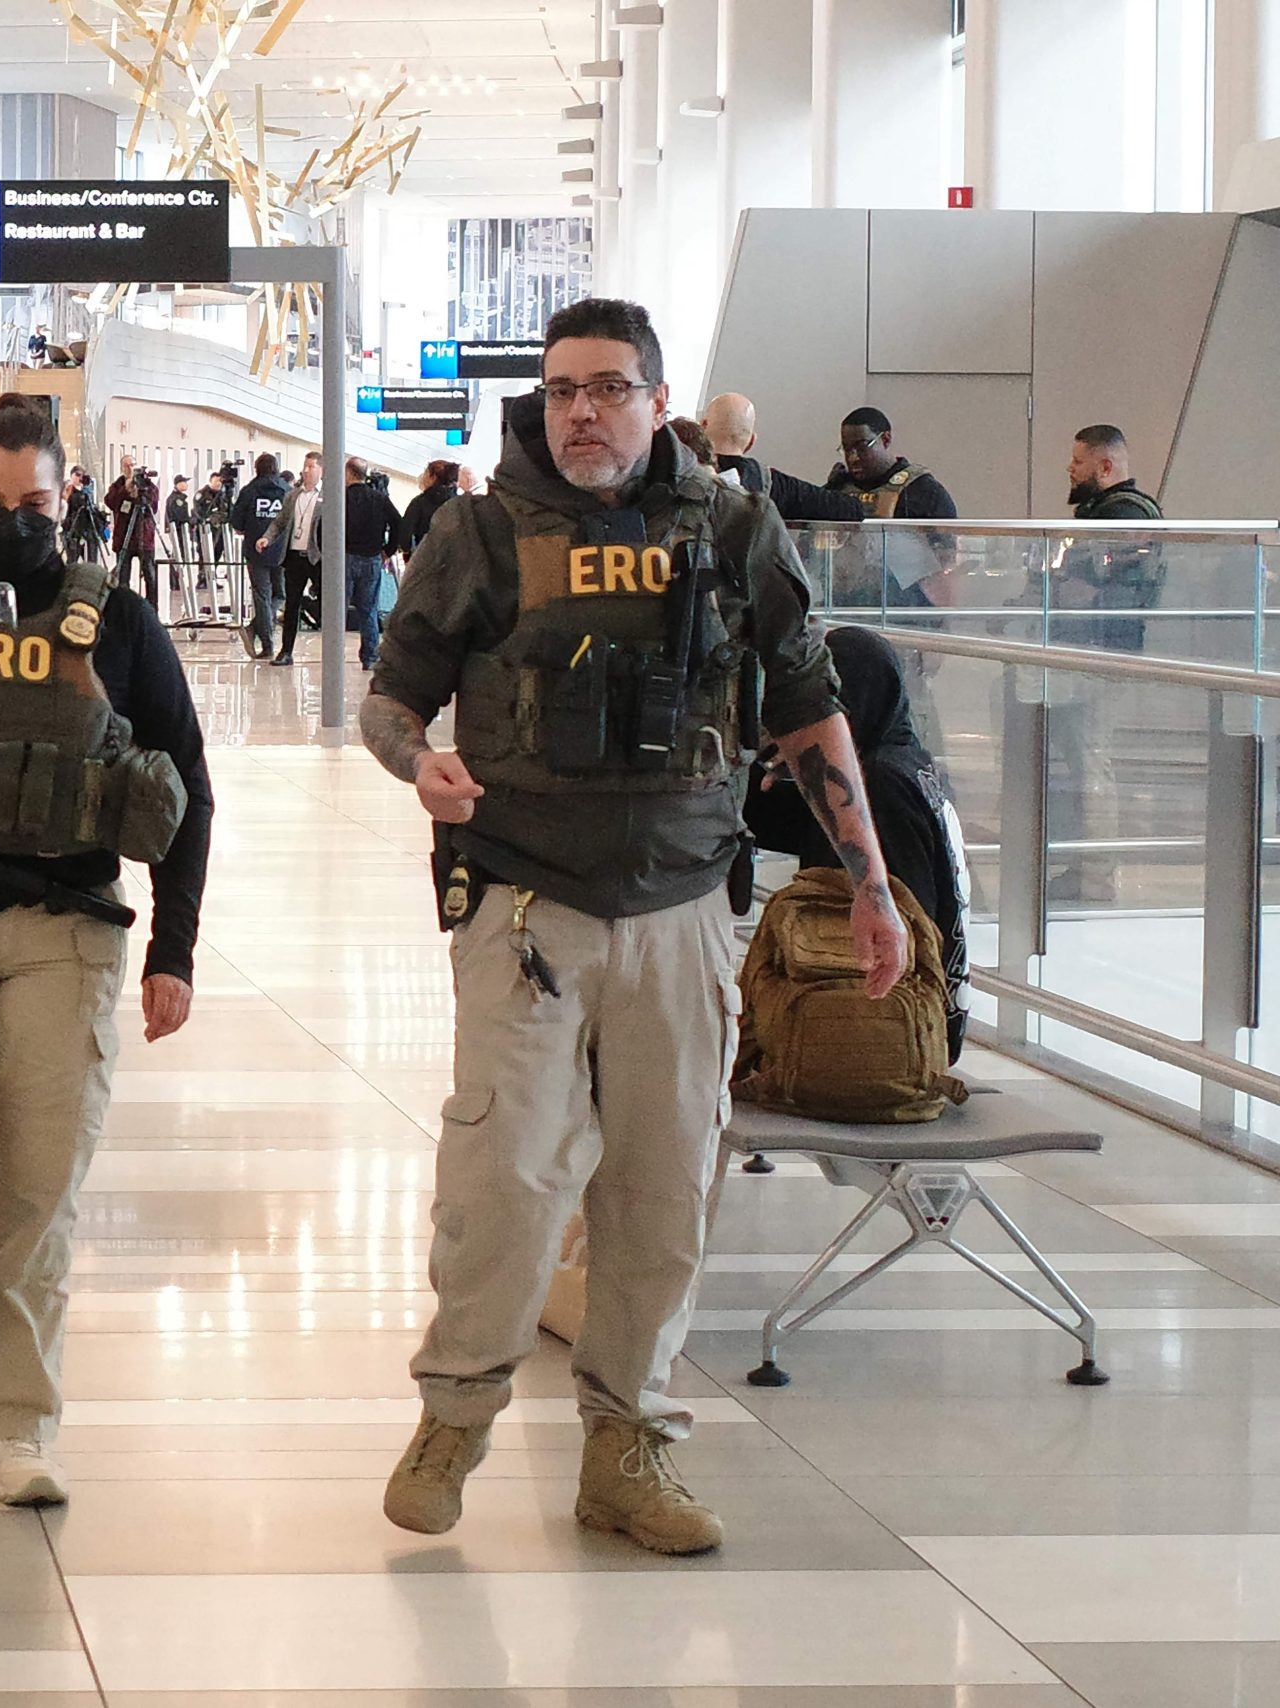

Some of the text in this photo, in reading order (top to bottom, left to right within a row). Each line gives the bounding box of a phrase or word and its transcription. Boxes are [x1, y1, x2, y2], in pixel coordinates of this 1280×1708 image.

[4, 189, 219, 206] Business/Conference Ctr.
[4, 222, 146, 239] Restaurant & Bar
[460, 345, 545, 356] Business/Confere
[570, 545, 671, 594] ERO
